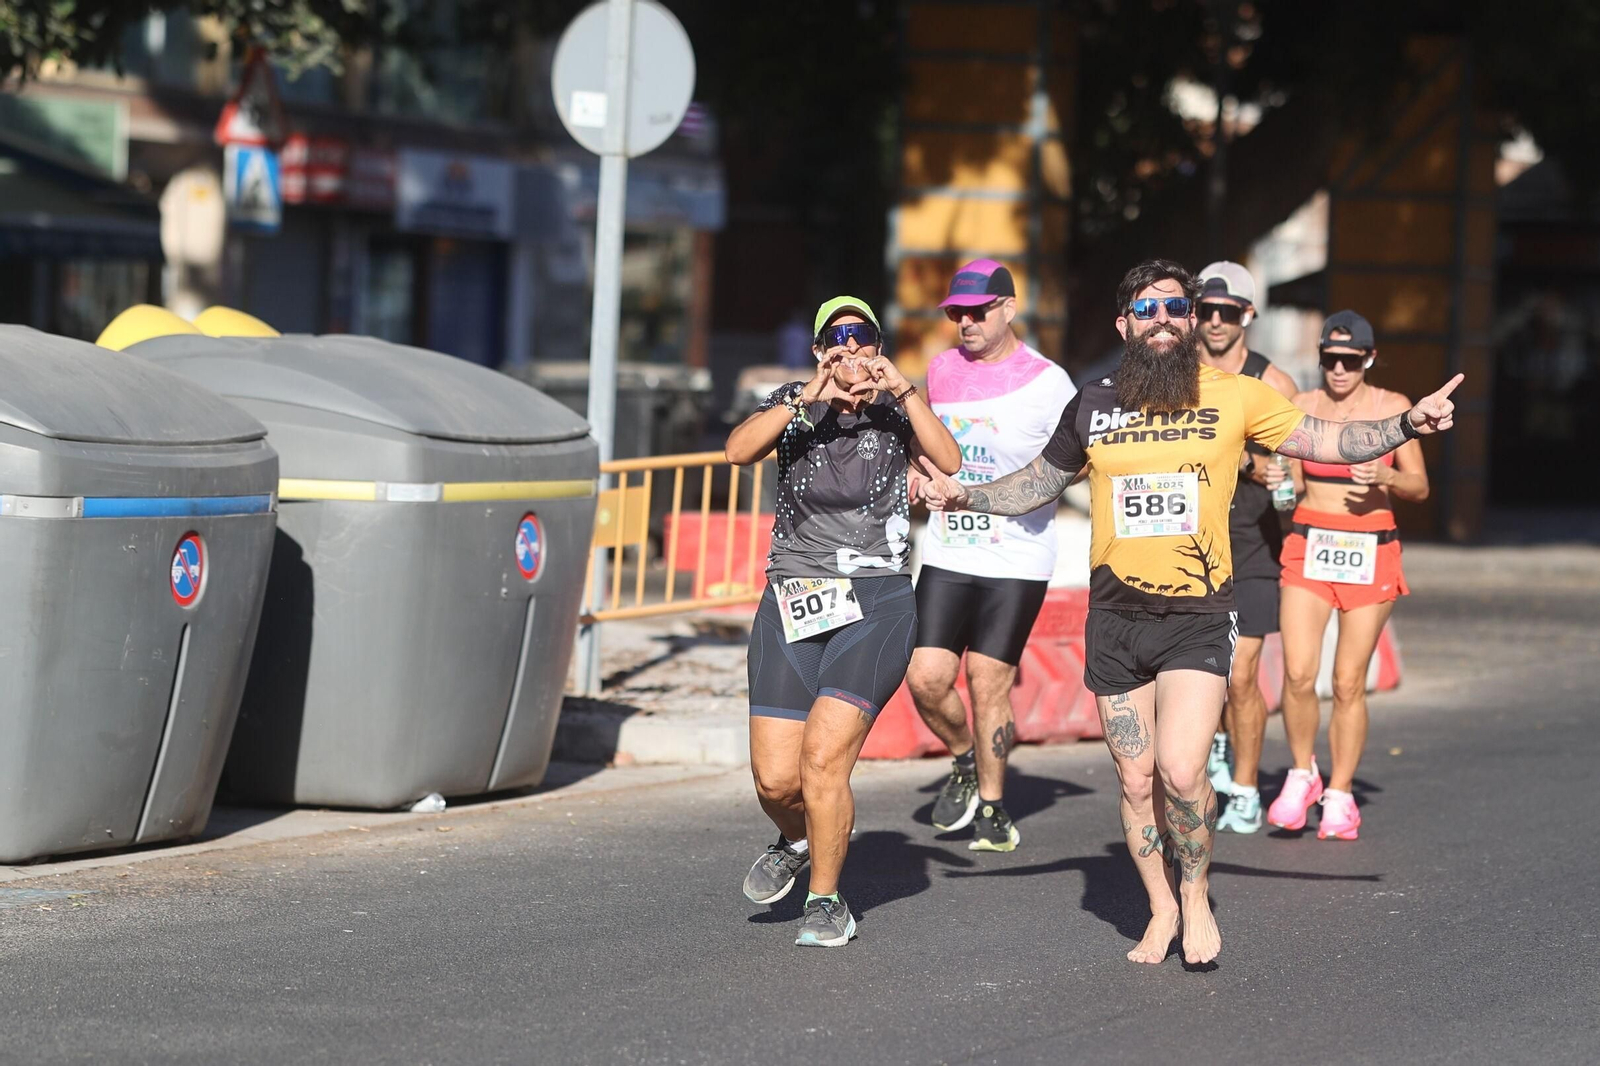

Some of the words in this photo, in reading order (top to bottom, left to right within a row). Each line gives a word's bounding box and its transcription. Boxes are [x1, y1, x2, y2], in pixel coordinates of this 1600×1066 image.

[1089, 408, 1219, 432] bichos
[1088, 427, 1217, 448] runners
[1123, 478, 1144, 491] XII
[1156, 481, 1184, 489] 2025
[1124, 493, 1186, 517] 586
[947, 514, 991, 531] 503
[1316, 549, 1363, 567] 480
[790, 587, 838, 621] 507
